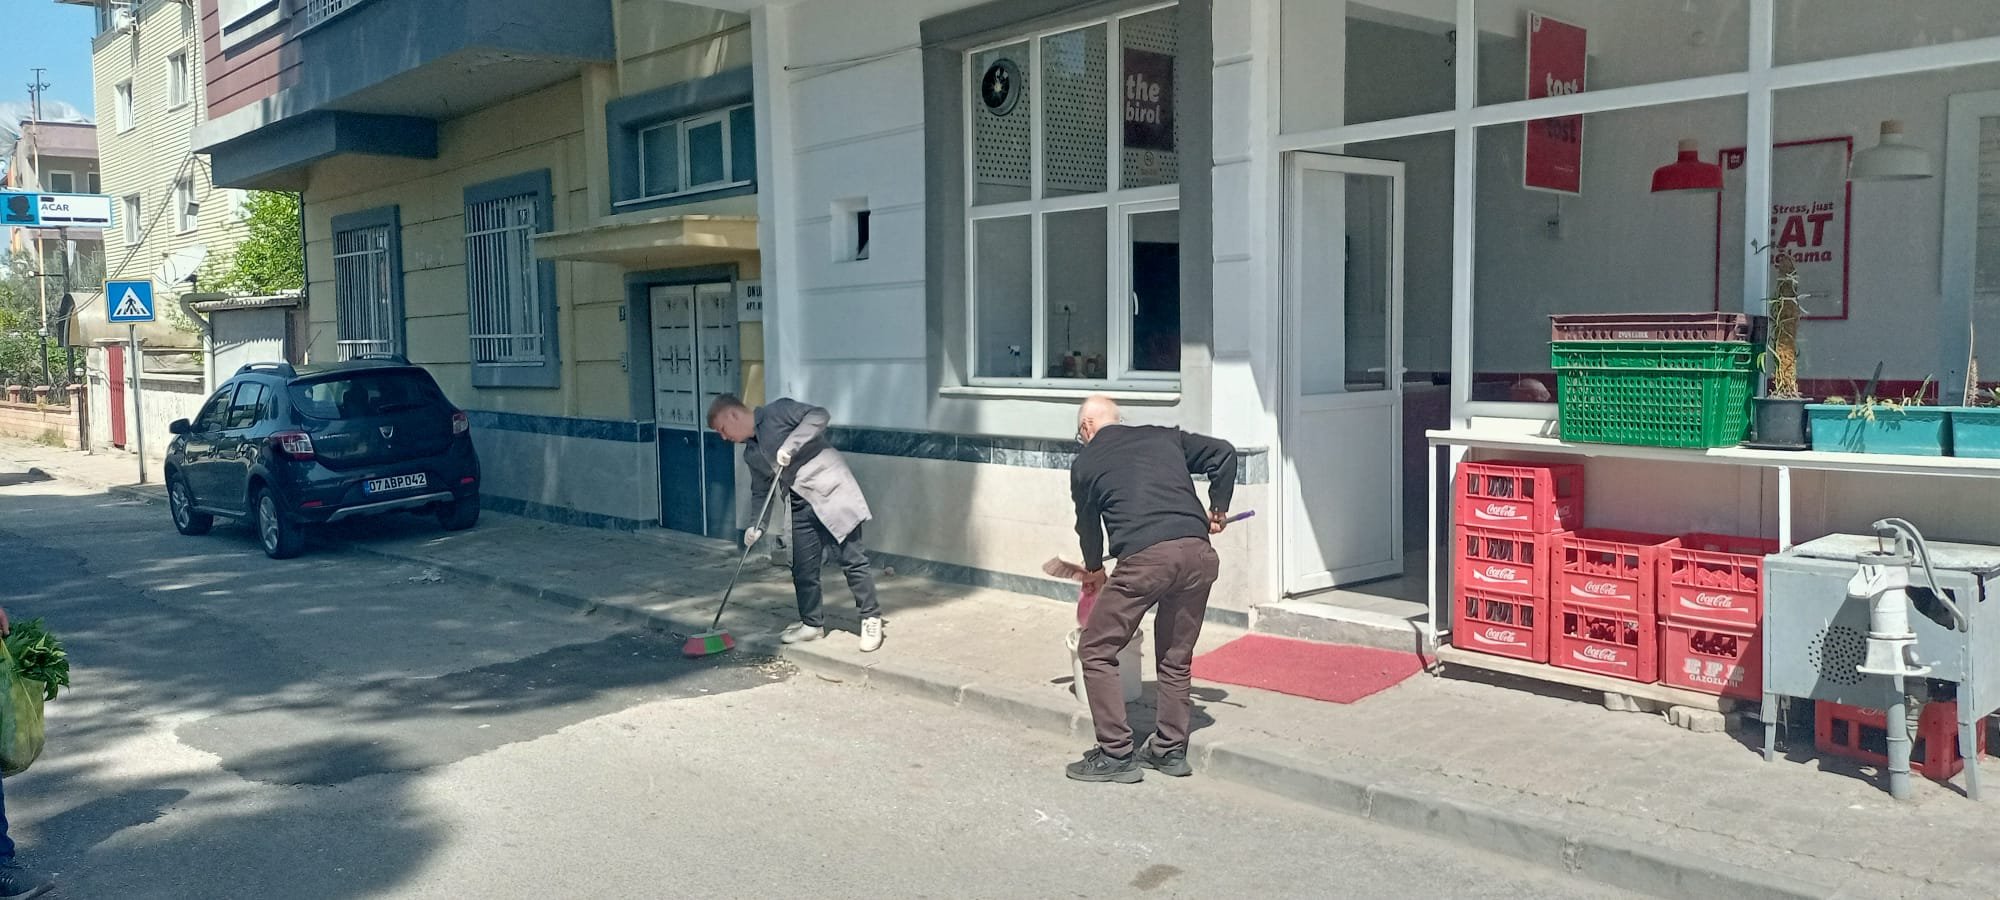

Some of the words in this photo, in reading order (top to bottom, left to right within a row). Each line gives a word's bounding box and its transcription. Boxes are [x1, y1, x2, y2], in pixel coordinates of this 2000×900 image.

[1126, 73, 1160, 102] the
[1126, 101, 1160, 124] birol
[41, 203, 70, 212] ACAR
[1772, 204, 1810, 214] Stress,
[1811, 201, 1834, 214] just
[747, 285, 762, 298] ONU
